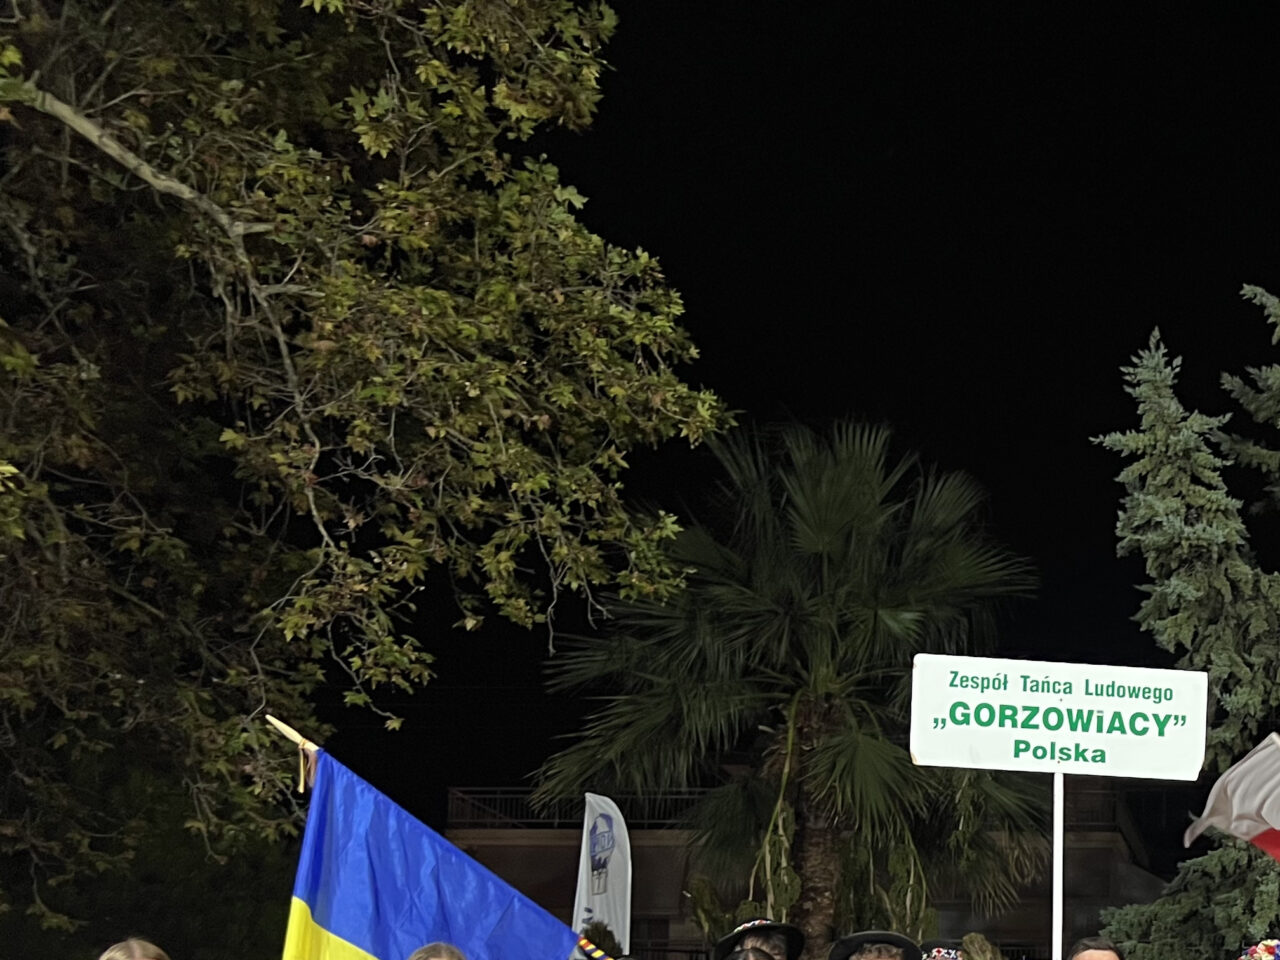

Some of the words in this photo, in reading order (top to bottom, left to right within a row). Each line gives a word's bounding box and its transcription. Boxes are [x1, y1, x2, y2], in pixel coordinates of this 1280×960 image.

[949, 671, 1008, 693] Zespół
[1020, 674, 1073, 695] Tańca
[1084, 678, 1173, 704] Ludowego
[1013, 739, 1107, 764] Polska
